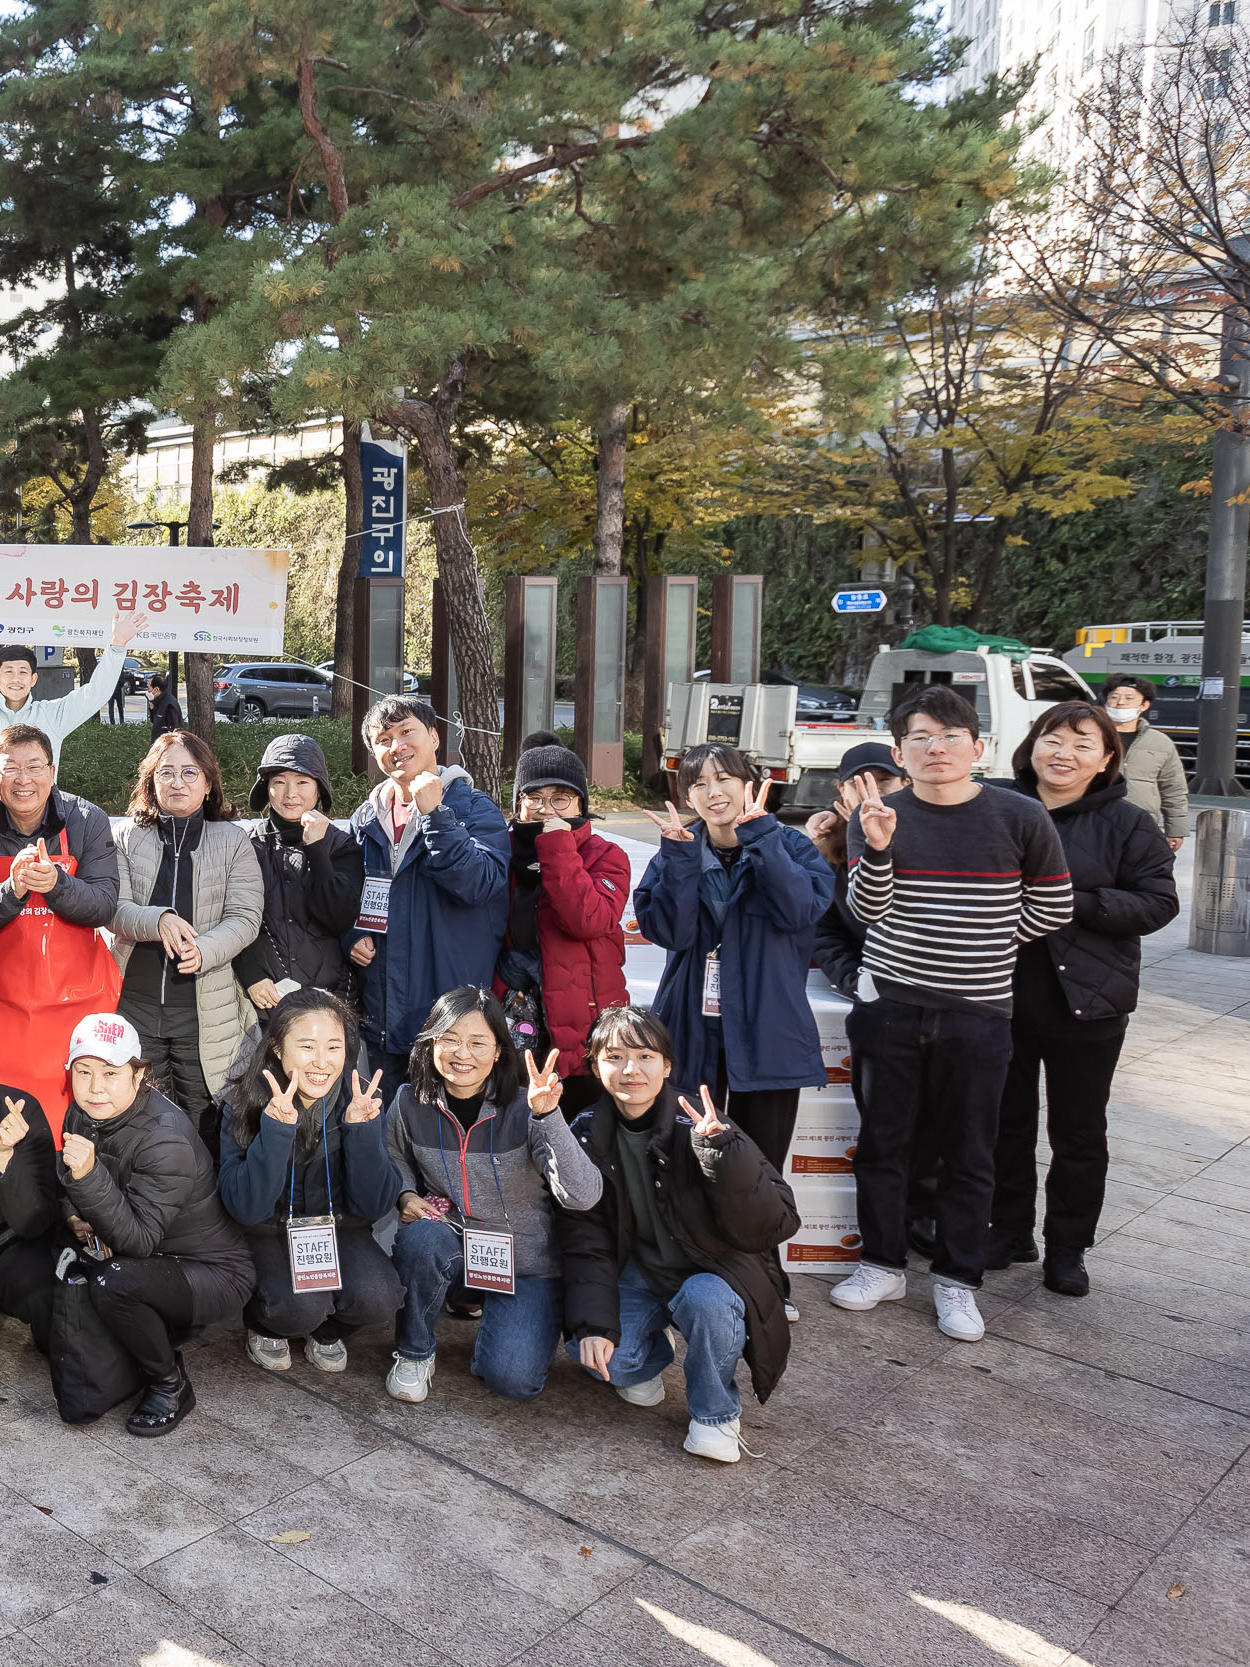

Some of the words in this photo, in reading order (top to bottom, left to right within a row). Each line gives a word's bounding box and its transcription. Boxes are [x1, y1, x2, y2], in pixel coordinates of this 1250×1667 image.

[371, 467, 397, 573] 광진구의
[5, 577, 99, 610] 사랑의
[112, 580, 239, 615] 김장축제
[7, 626, 34, 634] 광진구
[67, 628, 104, 637] 광진복지재단
[136, 631, 149, 639] KB
[150, 631, 177, 640] 국민은행
[44, 645, 56, 661] P
[297, 1241, 330, 1254] STAFF
[471, 1244, 507, 1258] STAFF
[296, 1252, 332, 1266] 진행요원
[470, 1254, 509, 1270] 진행요원
